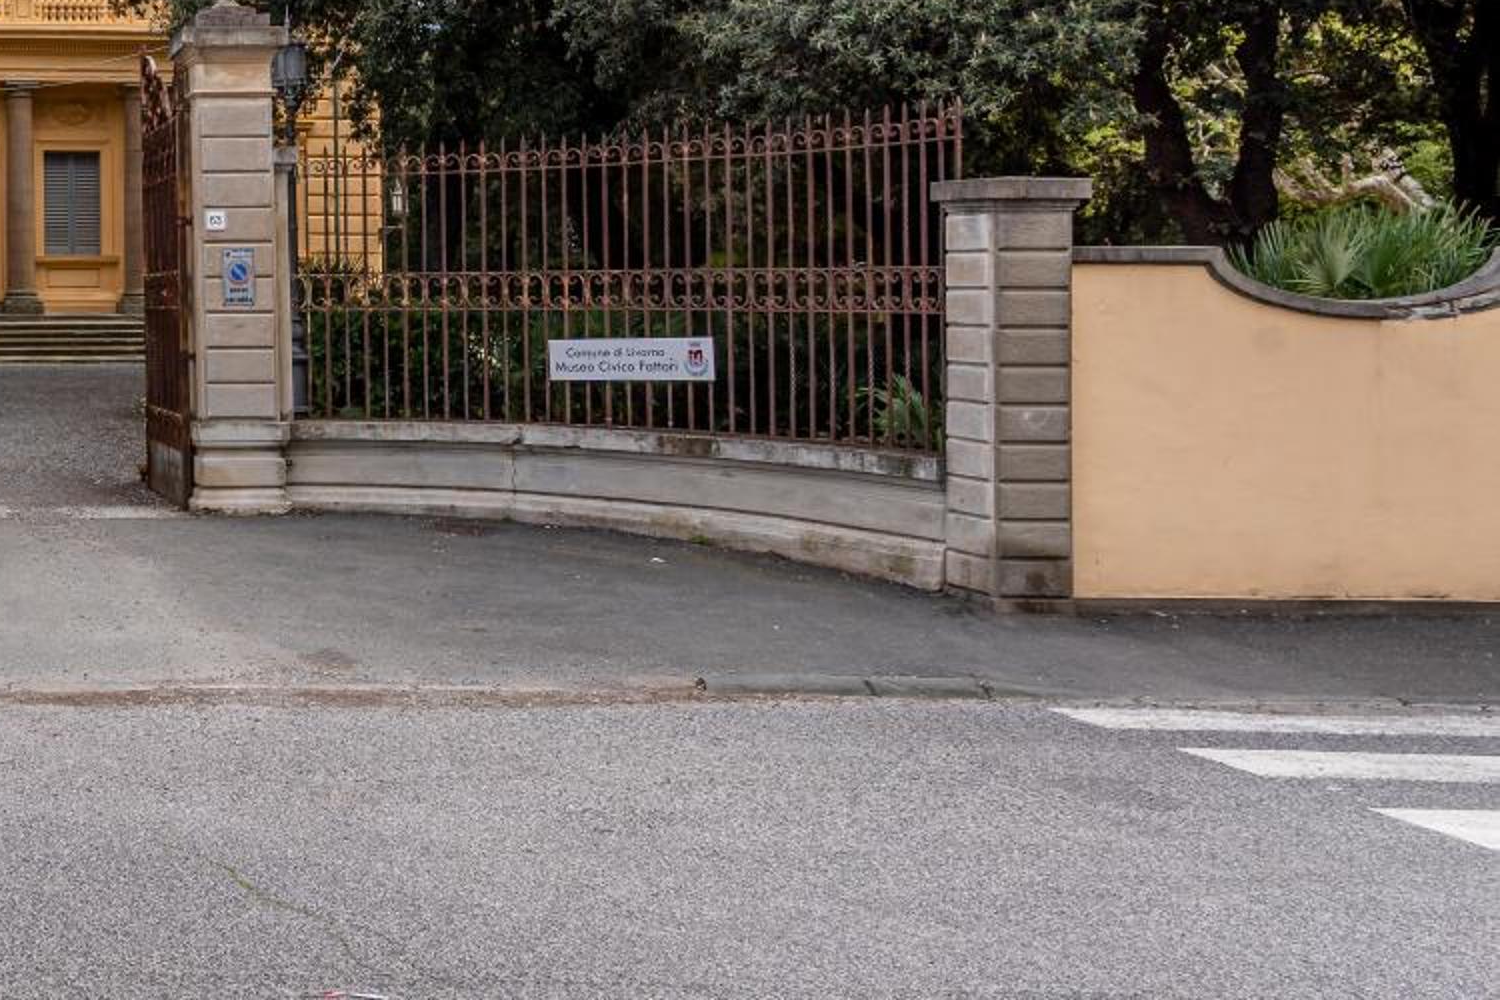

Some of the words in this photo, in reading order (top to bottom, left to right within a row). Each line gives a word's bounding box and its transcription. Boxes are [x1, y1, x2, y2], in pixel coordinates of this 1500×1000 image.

[565, 347, 611, 359] Comune
[614, 347, 625, 357] di
[627, 347, 665, 357] Livorno
[556, 361, 595, 373] Museo
[599, 361, 635, 373] Civico
[639, 361, 679, 373] Fattori
